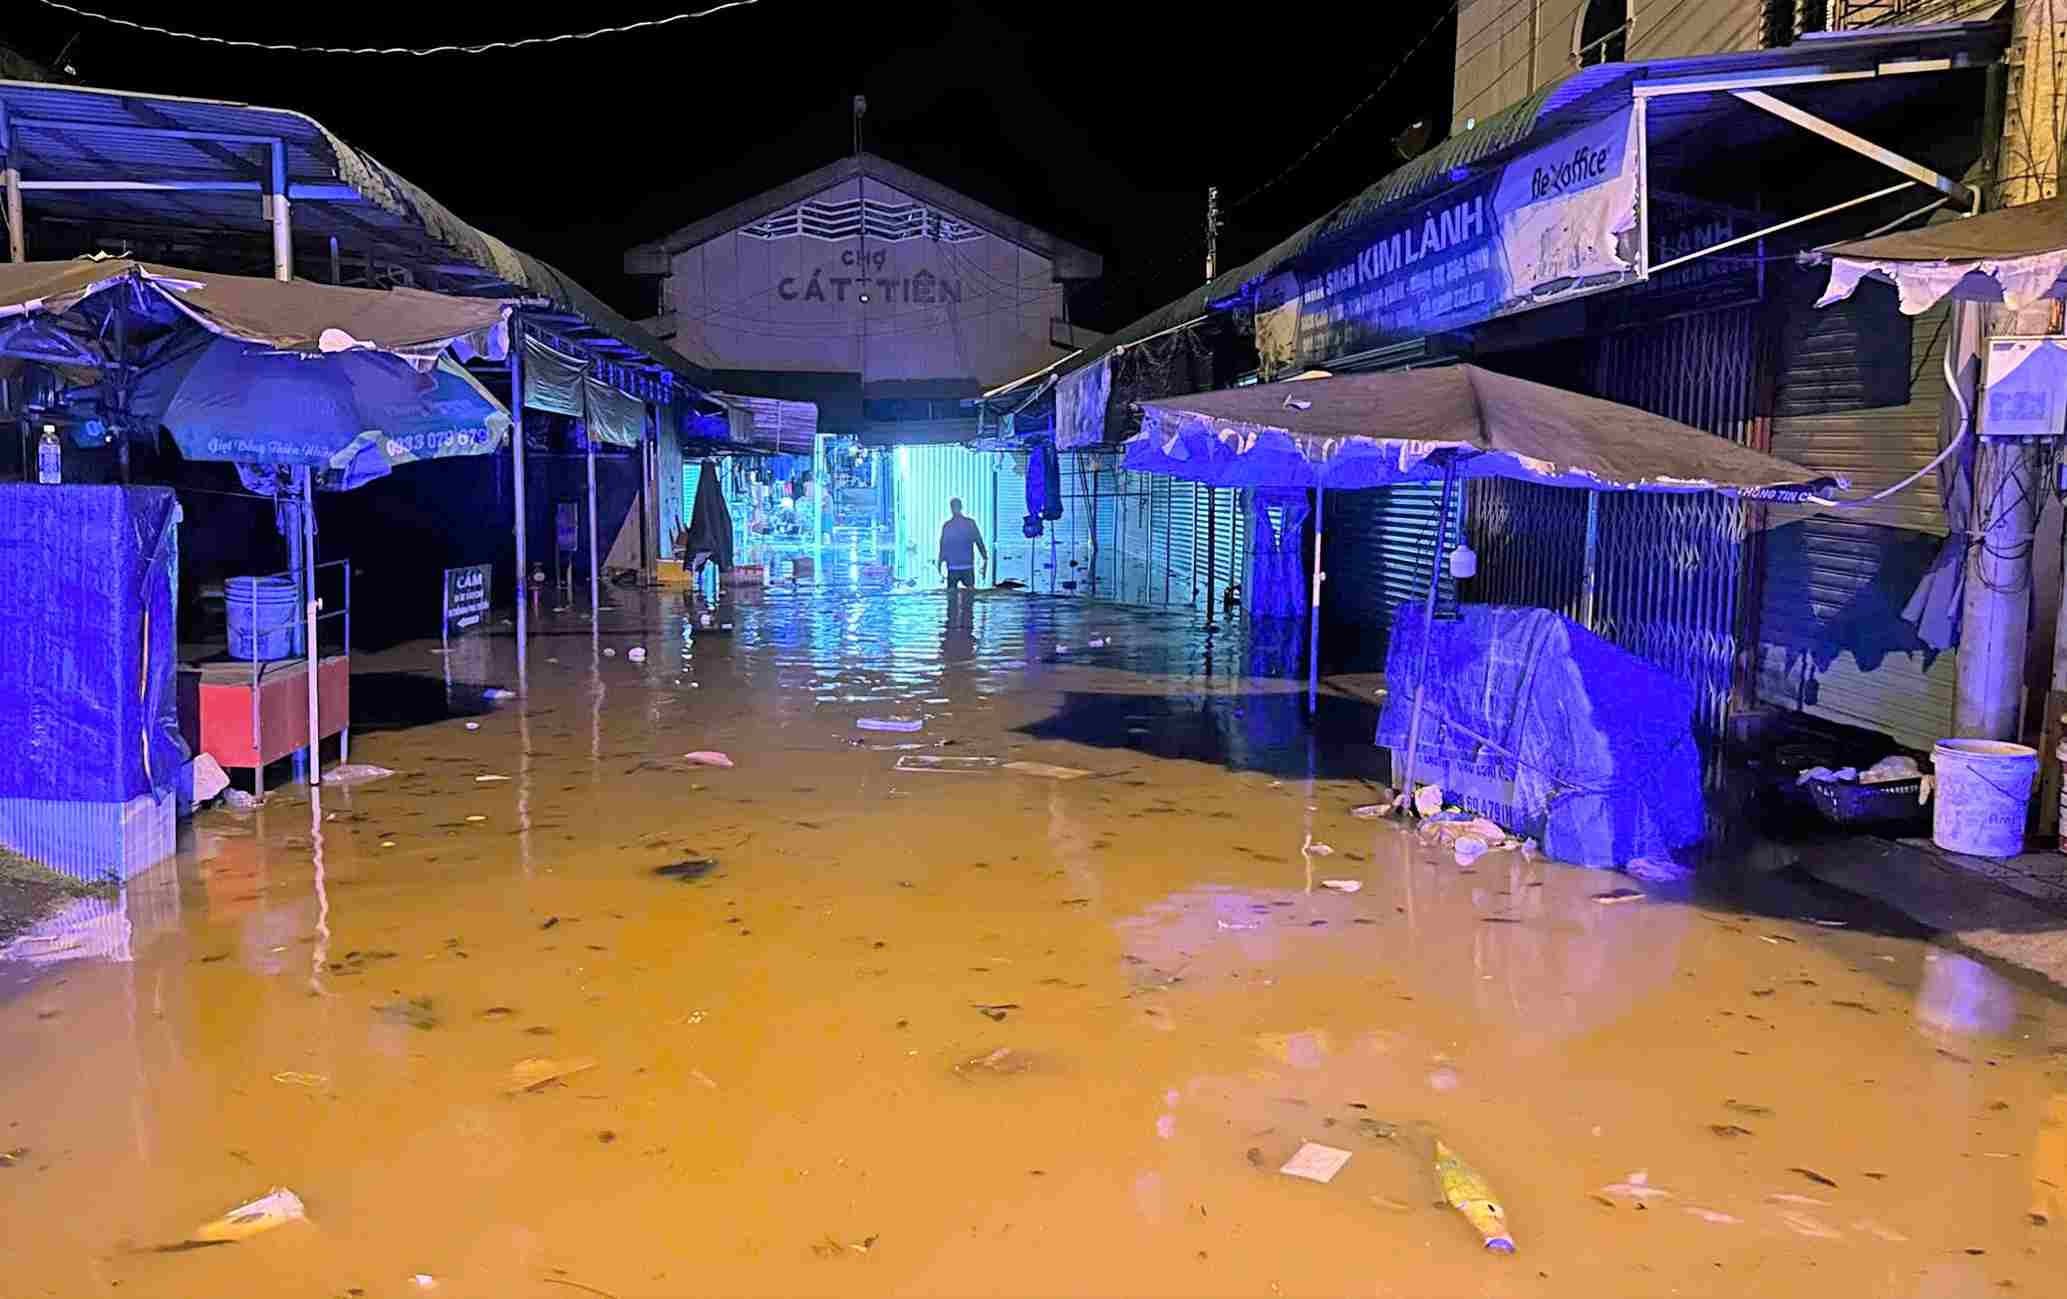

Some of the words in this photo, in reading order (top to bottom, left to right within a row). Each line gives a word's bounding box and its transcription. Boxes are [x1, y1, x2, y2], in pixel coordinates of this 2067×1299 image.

[1357, 232, 1401, 285] KIM
[1404, 195, 1483, 265] LÀNH
[841, 249, 888, 272] CHỢ
[777, 267, 853, 303] CÁT
[875, 267, 963, 304] TIÊN
